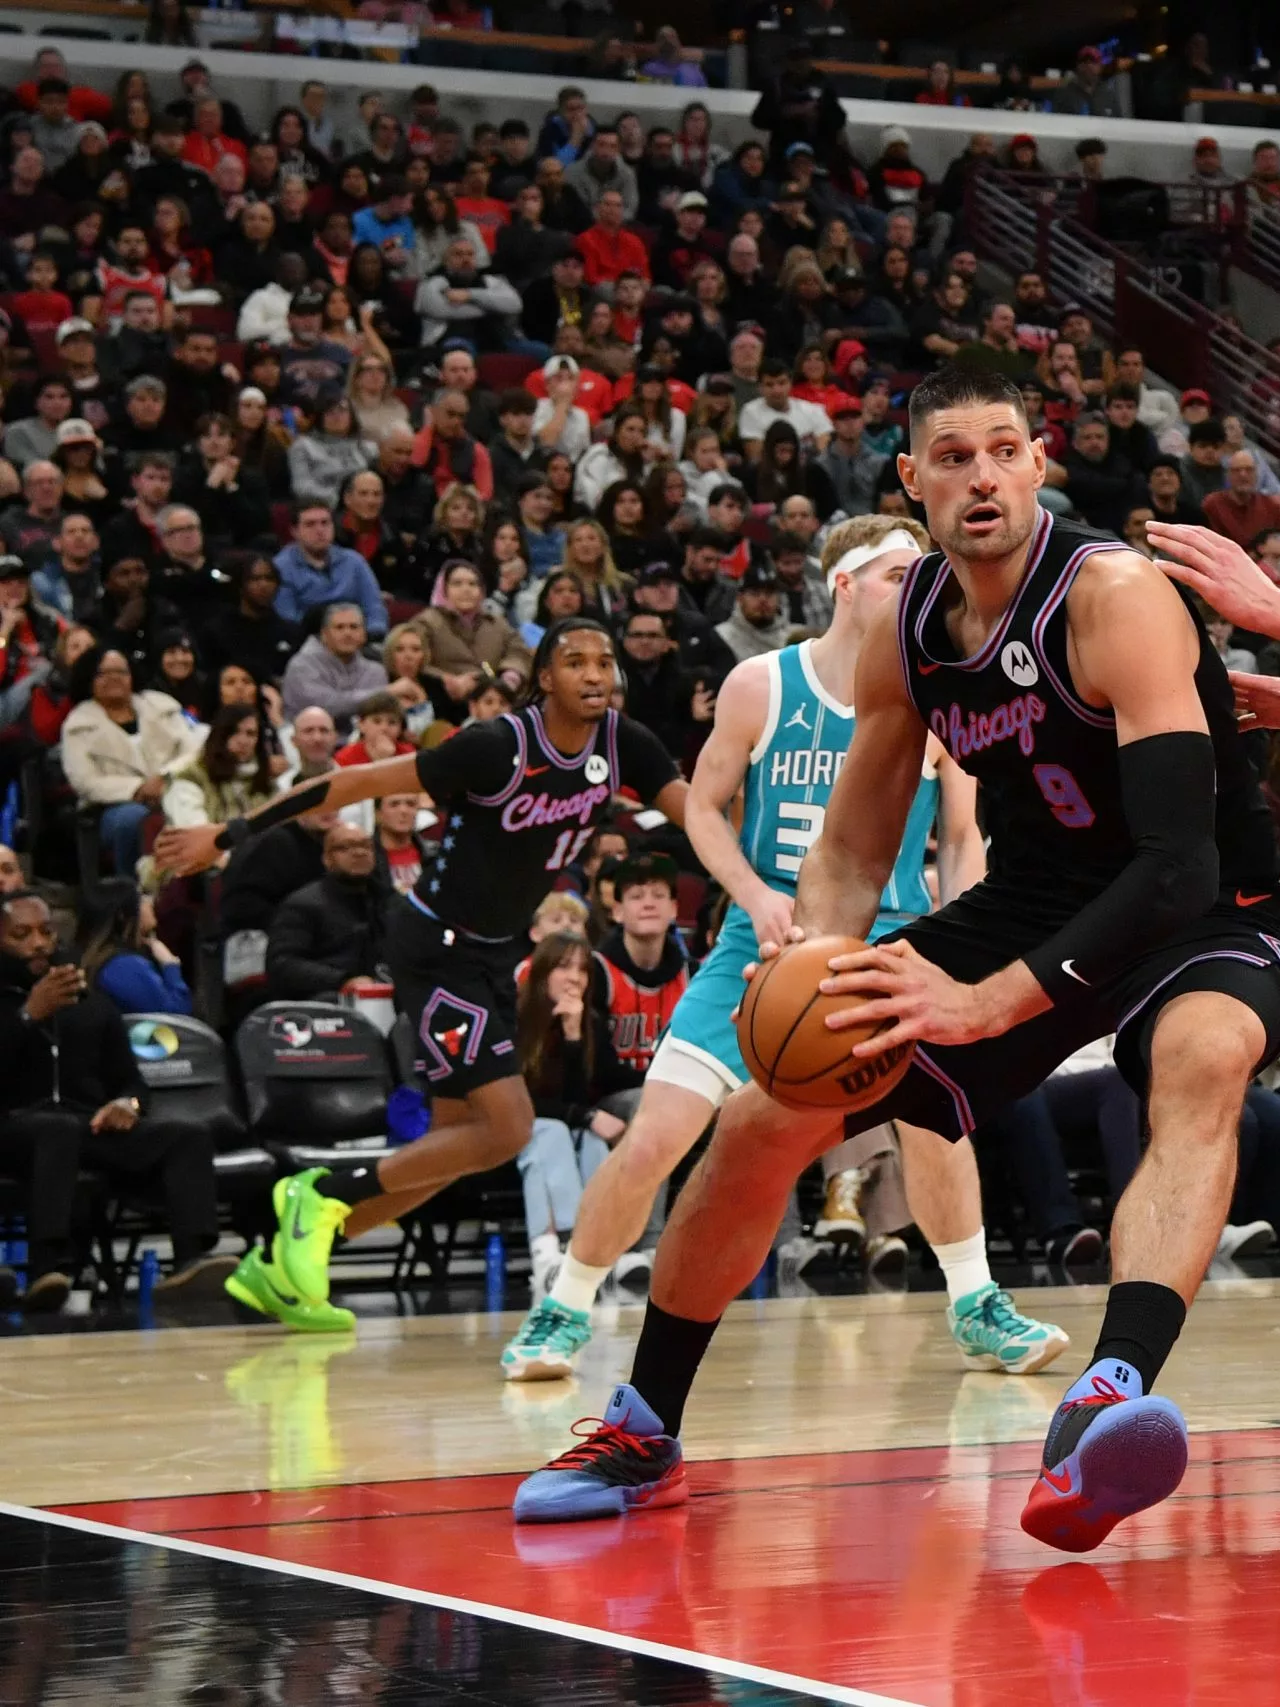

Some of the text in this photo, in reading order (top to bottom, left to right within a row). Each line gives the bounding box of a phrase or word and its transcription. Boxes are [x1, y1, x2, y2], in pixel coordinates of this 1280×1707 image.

[501, 783, 610, 833] Chicago
[1033, 764, 1096, 829] 9
[775, 801, 826, 873] 3
